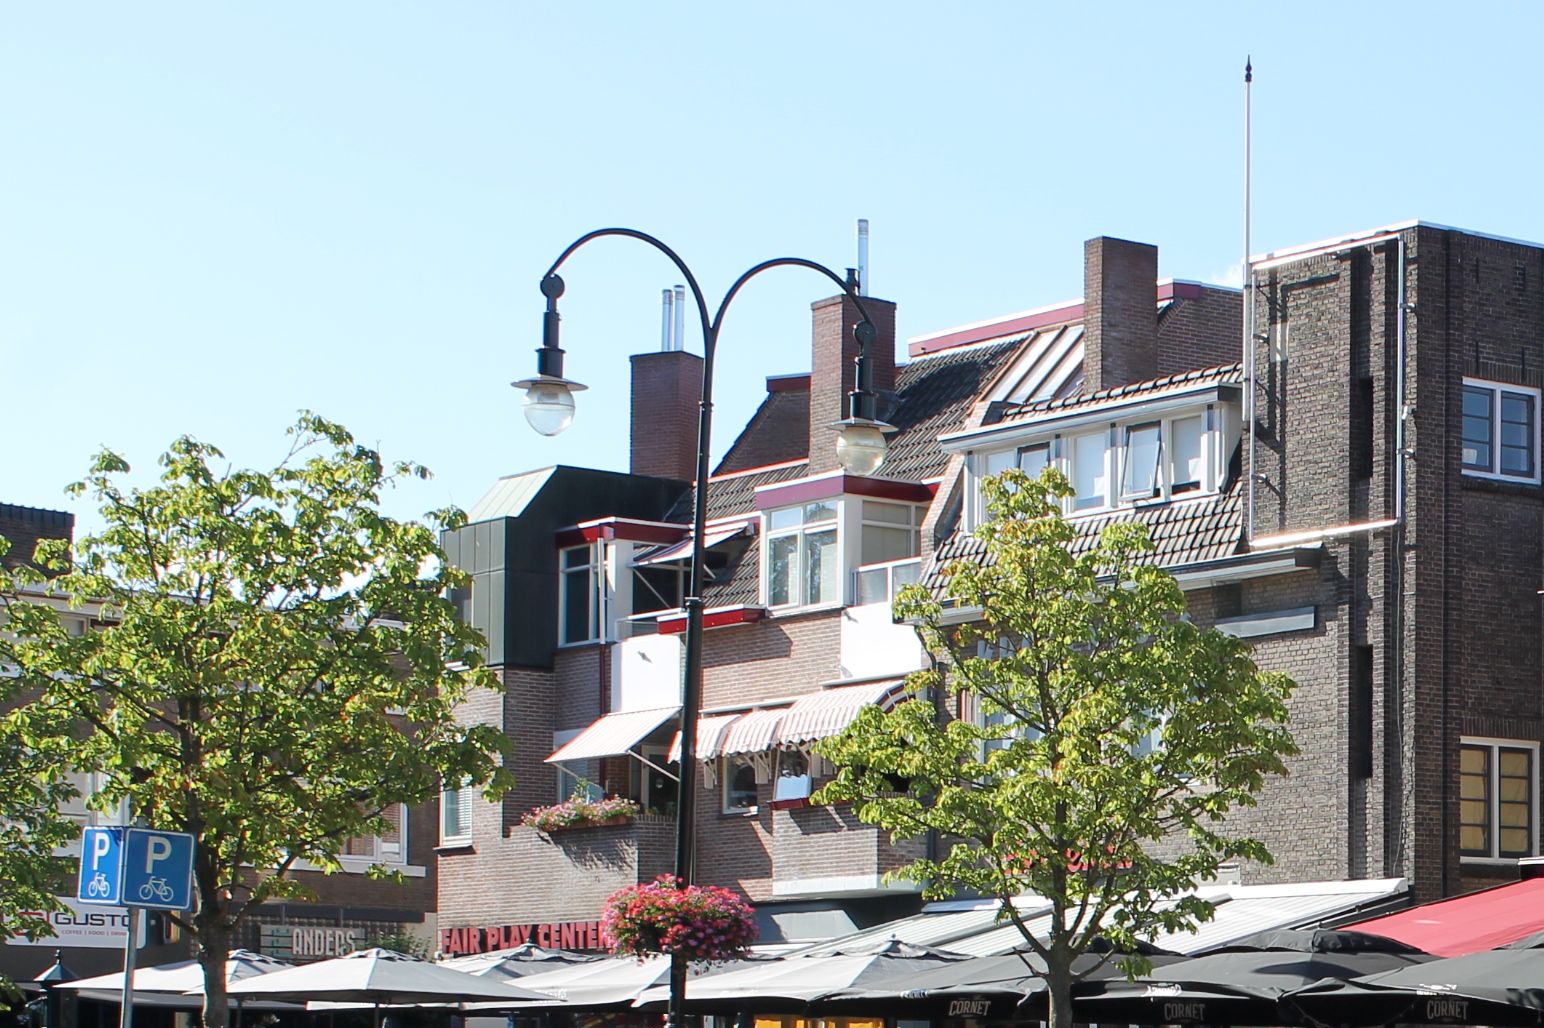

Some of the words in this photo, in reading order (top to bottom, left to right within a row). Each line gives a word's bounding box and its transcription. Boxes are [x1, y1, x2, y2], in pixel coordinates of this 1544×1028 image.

[92, 832, 110, 870] P
[145, 836, 172, 874] P
[293, 928, 357, 956] ANDERS
[441, 928, 481, 954] FAIR
[486, 924, 533, 950] PLAY
[538, 921, 612, 949] CENTER
[948, 1000, 991, 1016] CORNET
[1164, 1003, 1206, 1021] CORNET
[1427, 1000, 1469, 1019] CORNET
